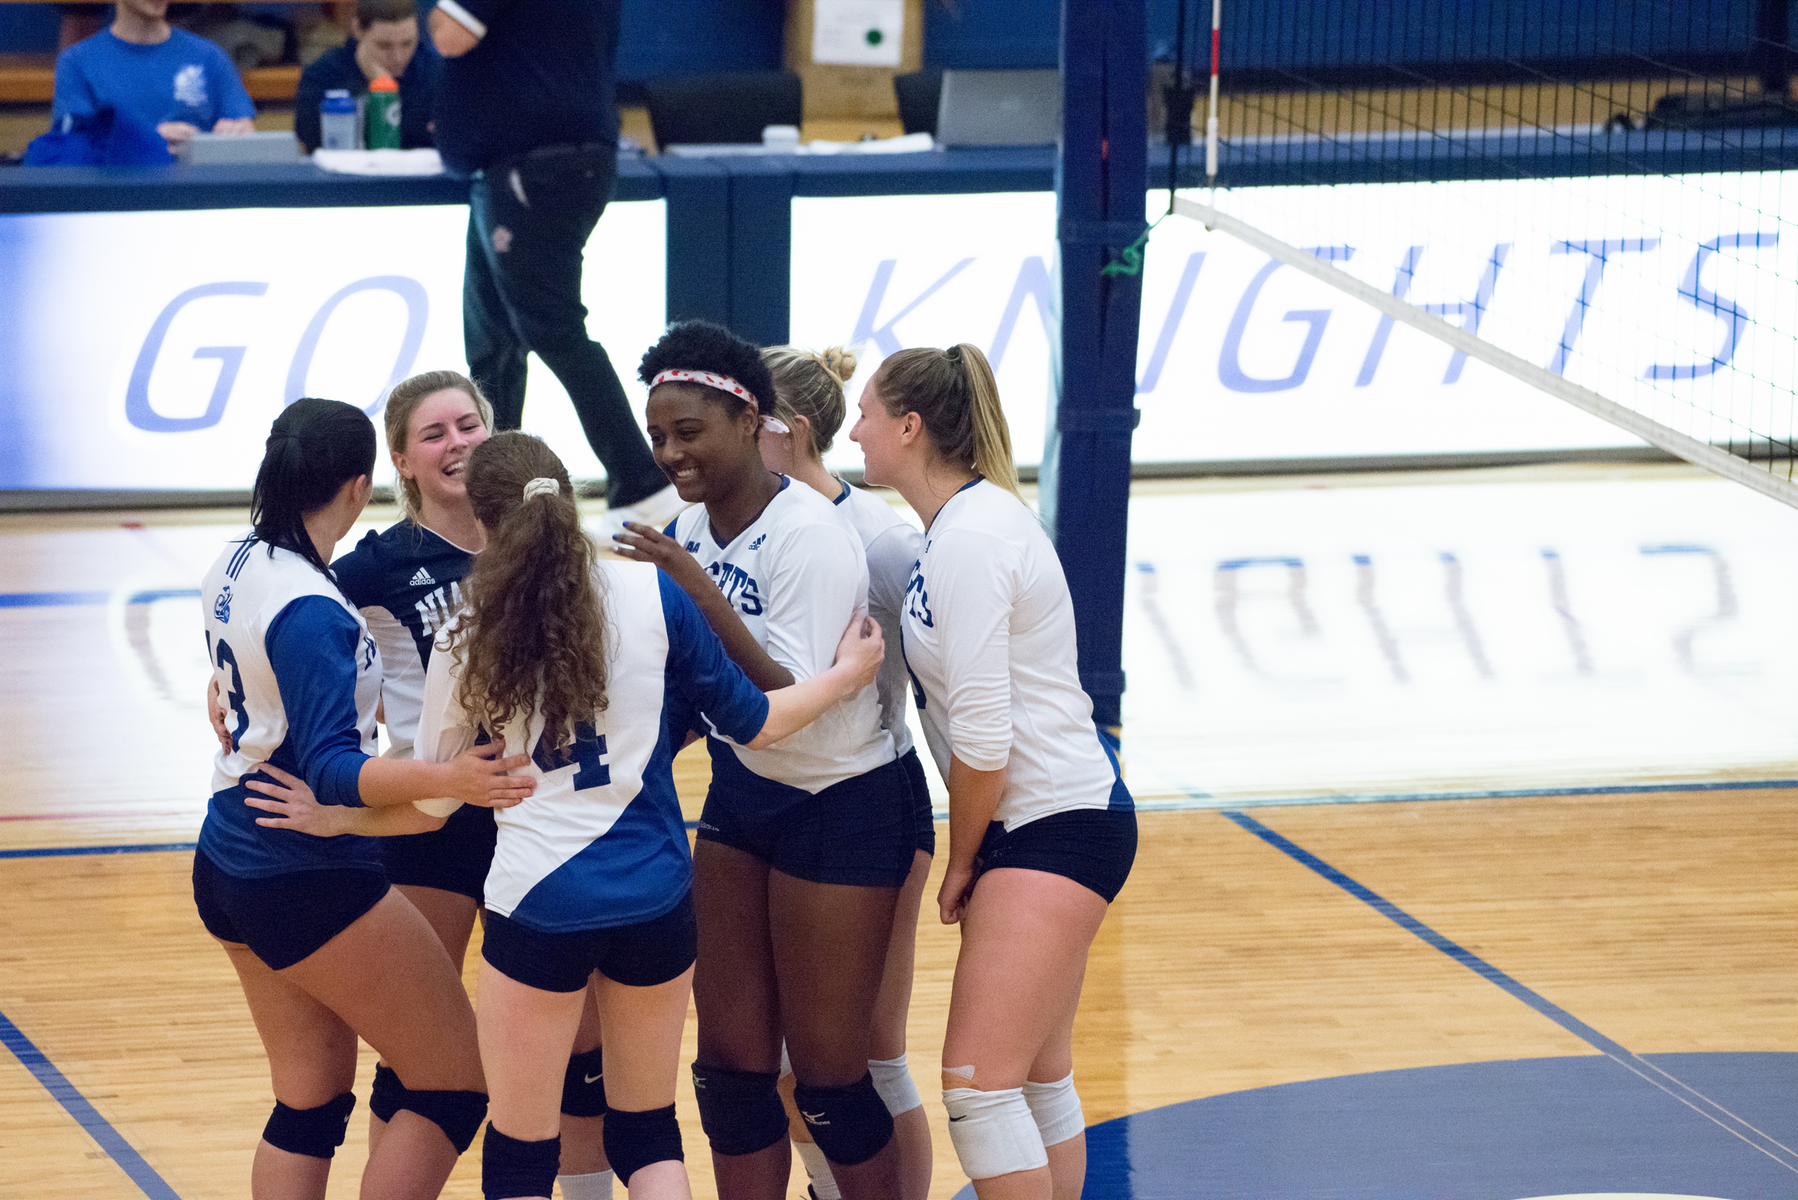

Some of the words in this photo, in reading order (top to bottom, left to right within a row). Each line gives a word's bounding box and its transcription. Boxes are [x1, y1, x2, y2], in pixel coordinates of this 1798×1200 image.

[125, 276, 429, 432] GO
[409, 578, 436, 586] adidas
[205, 630, 249, 754] 3
